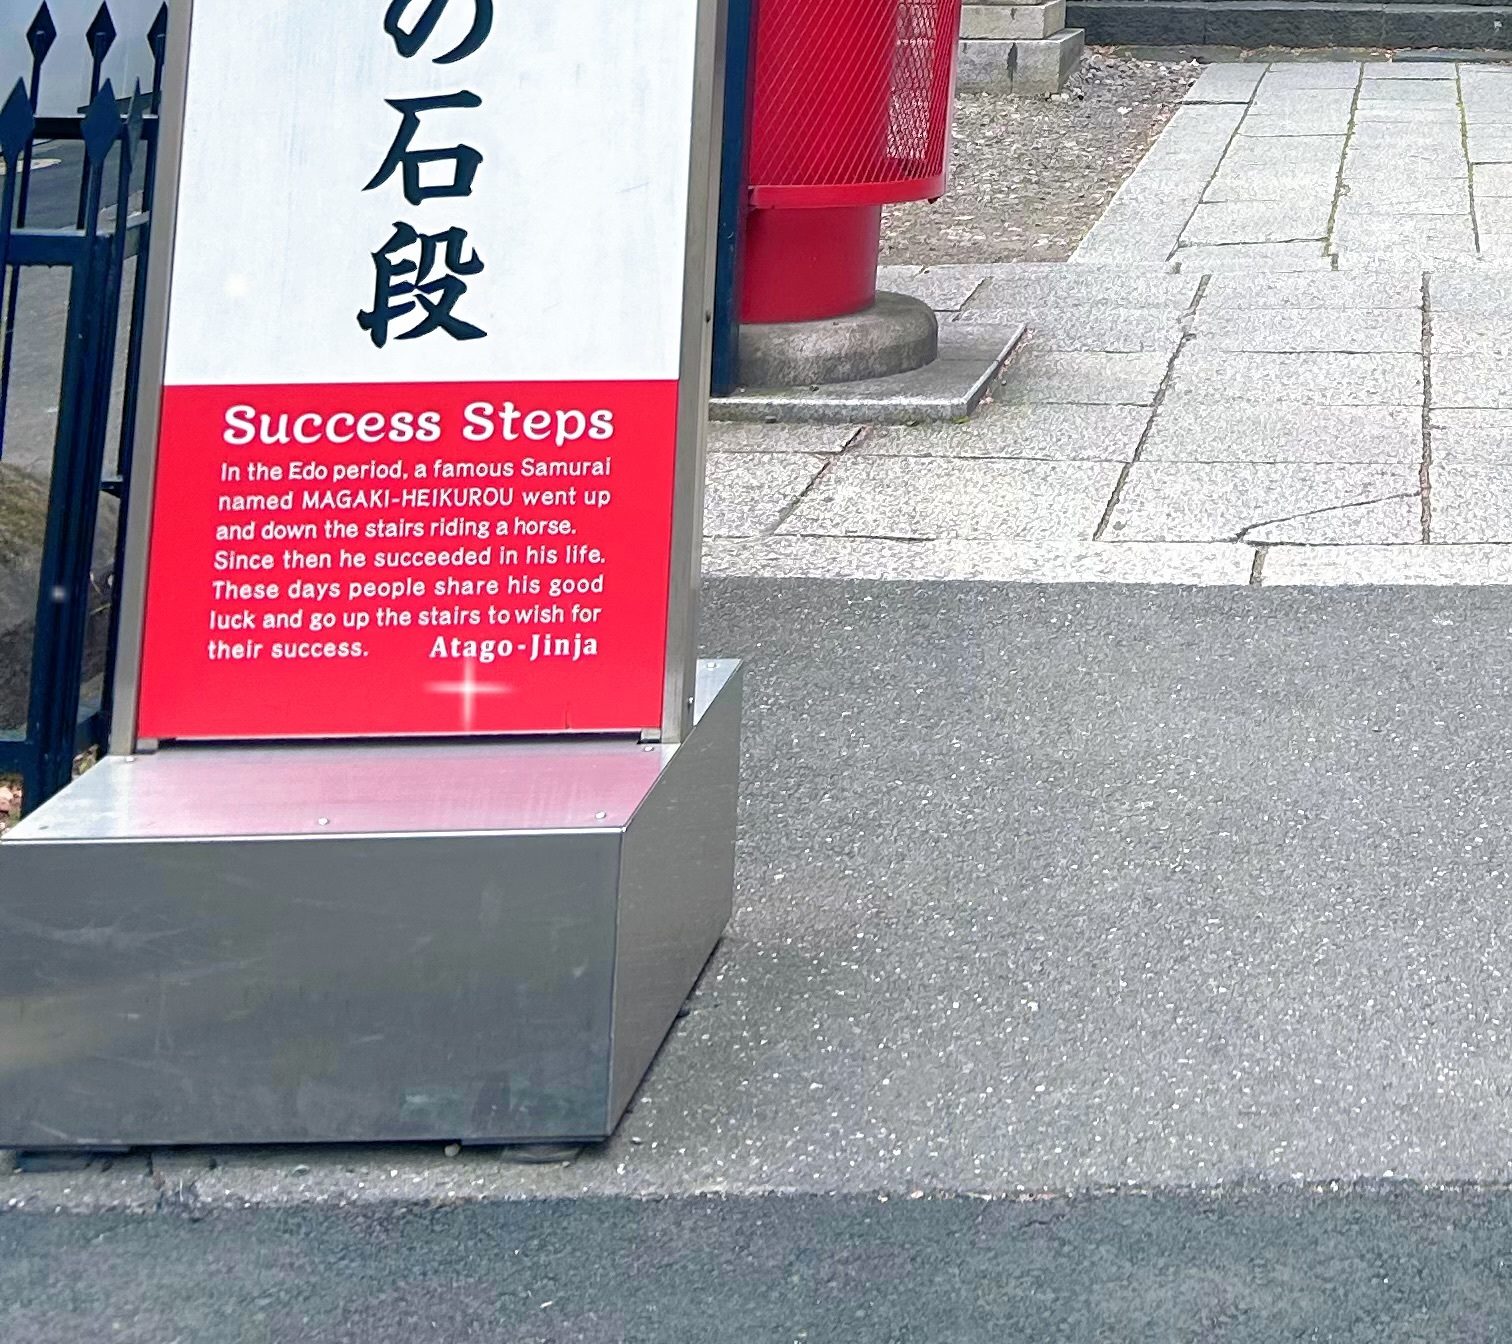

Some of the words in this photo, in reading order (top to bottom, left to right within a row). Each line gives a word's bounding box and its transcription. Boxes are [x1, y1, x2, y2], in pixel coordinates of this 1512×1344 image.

[223, 404, 441, 445] Success
[462, 401, 614, 447] Steps
[221, 462, 240, 481] In
[247, 462, 283, 481] the
[288, 461, 328, 480] Edo
[332, 459, 408, 483] period,
[414, 463, 427, 478] a
[433, 458, 514, 478] famous
[520, 456, 611, 477] Samurai
[218, 490, 294, 511] named
[302, 487, 514, 510] MAGAKI-HEIKUROU
[522, 486, 577, 506] went
[584, 490, 611, 508] up
[215, 521, 256, 541] and
[261, 520, 317, 540] down
[324, 519, 359, 539] the
[364, 518, 425, 538] stairs
[430, 517, 490, 539] riding
[495, 520, 509, 536] a
[513, 516, 577, 535] horse.
[213, 550, 274, 570] Since
[282, 549, 332, 569] then
[339, 548, 366, 568] he
[373, 546, 492, 568] succeeded
[499, 545, 518, 565] in
[526, 545, 558, 565] his
[565, 544, 606, 564] life.
[212, 580, 280, 600] These
[287, 579, 341, 601] days
[348, 577, 426, 601] people
[434, 576, 499, 596] share
[507, 575, 541, 595] his
[548, 574, 604, 597] good
[209, 609, 256, 630] luck
[262, 608, 303, 629] and
[309, 612, 337, 631] go
[343, 611, 370, 630] up
[375, 607, 412, 627] the
[417, 605, 481, 626] stairs
[487, 605, 511, 625] to
[514, 604, 564, 624] wish
[571, 603, 602, 623] for
[207, 639, 264, 660] their
[271, 641, 369, 659] success.
[429, 633, 598, 662] Atago-Jinja
